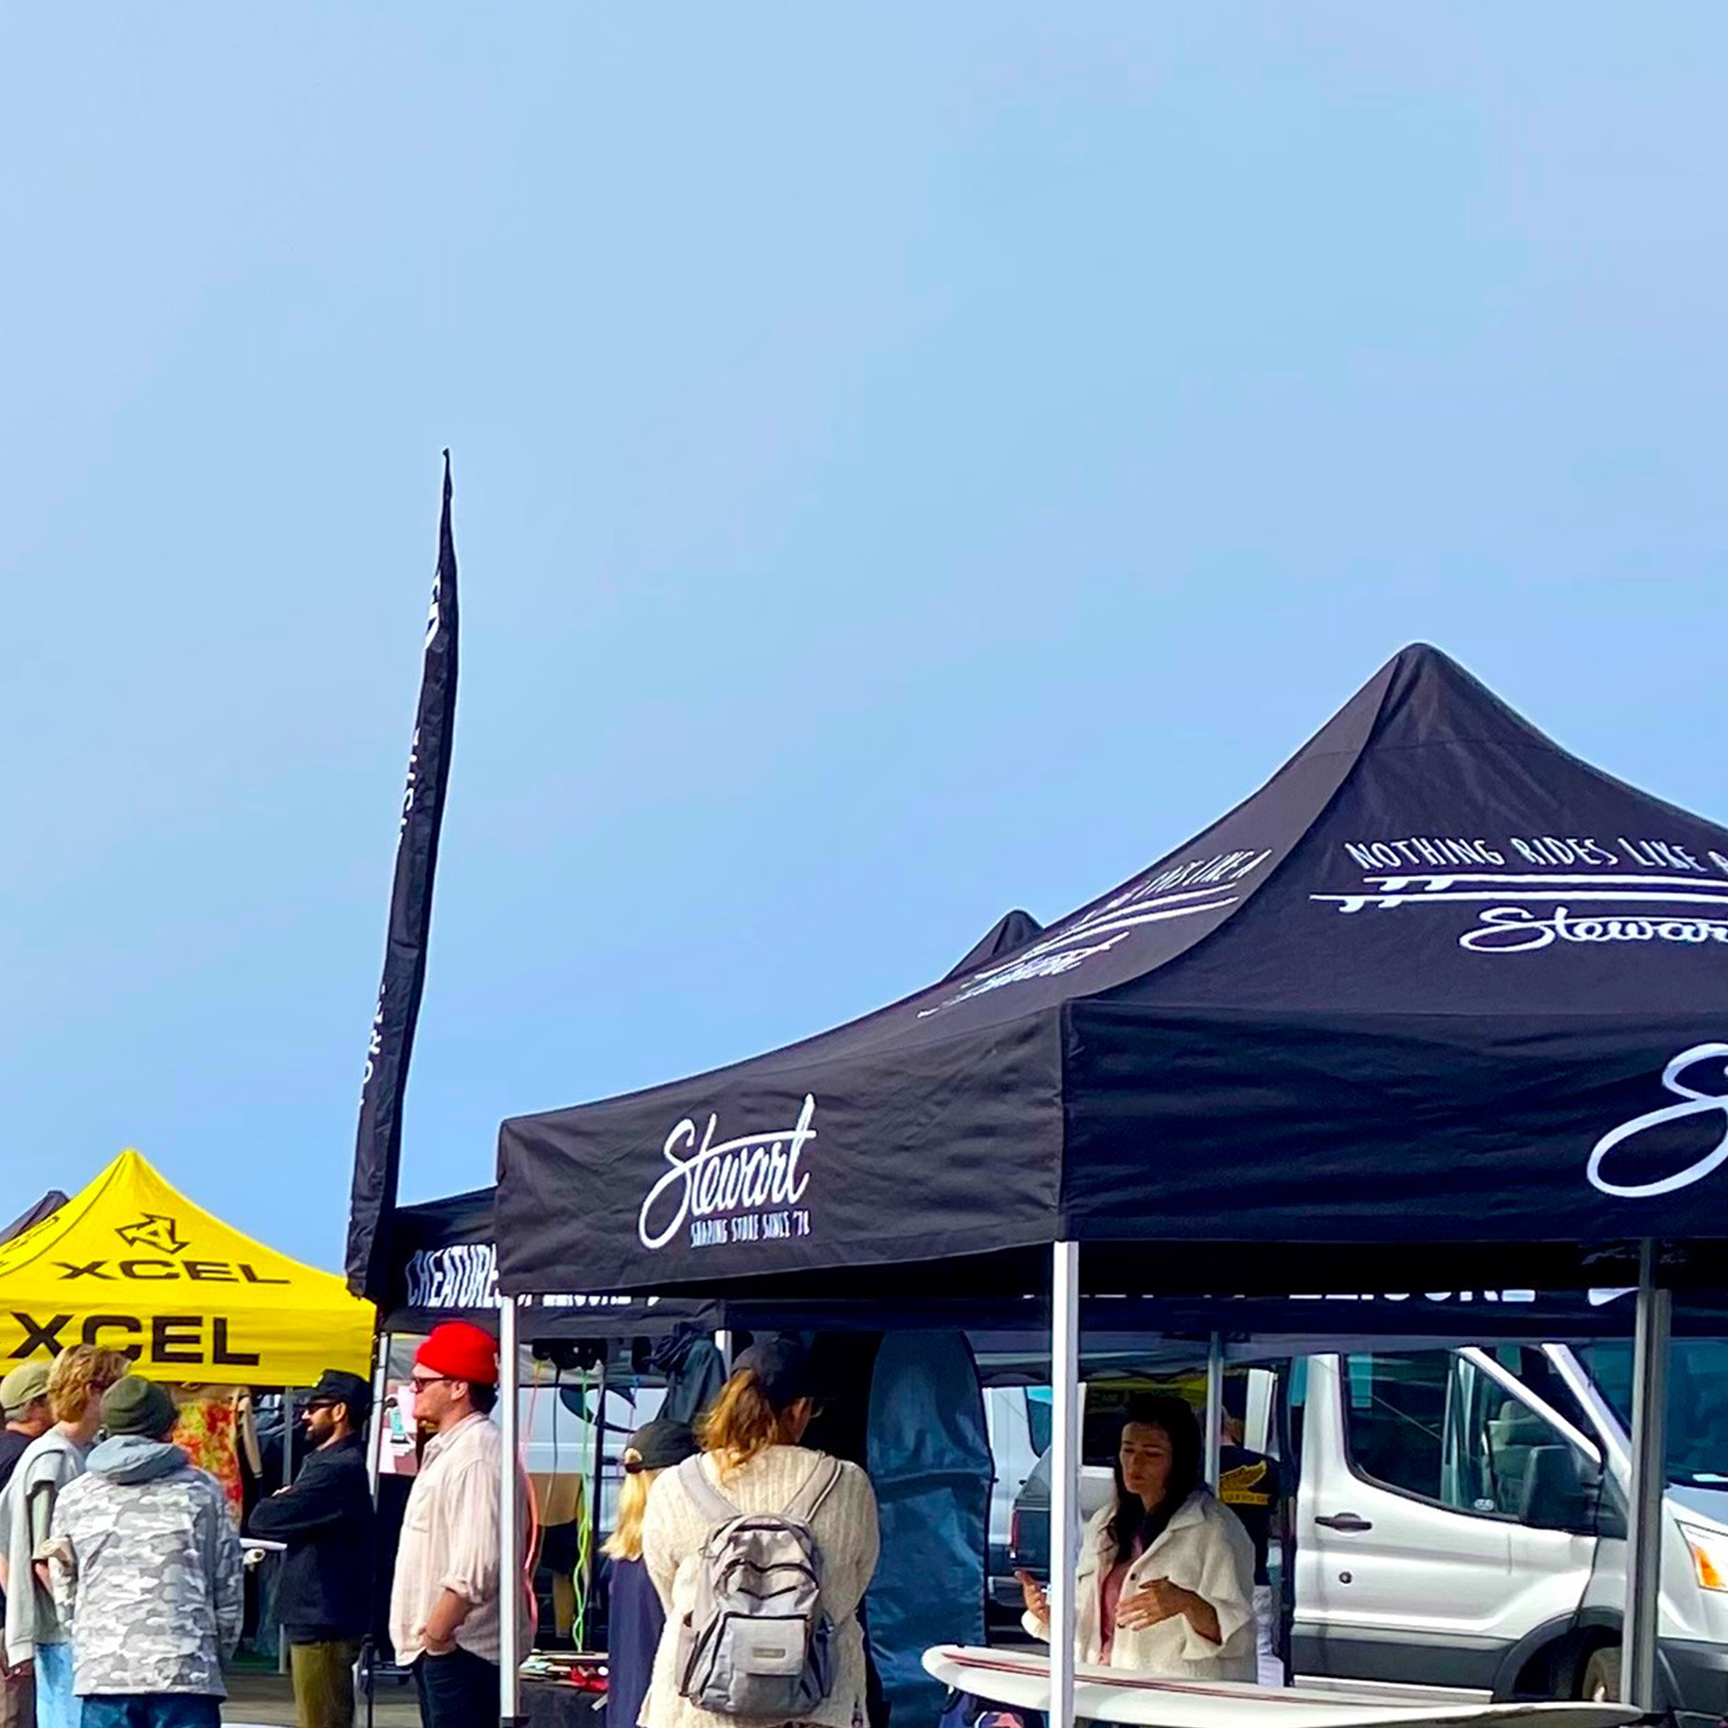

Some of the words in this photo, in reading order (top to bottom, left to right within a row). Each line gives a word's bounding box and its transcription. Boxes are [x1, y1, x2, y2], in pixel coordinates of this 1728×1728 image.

[1345, 838, 1505, 870] NOTHING
[1510, 836, 1618, 867] RIDES
[1618, 838, 1709, 873] LIKE
[1459, 906, 1728, 953] Stewar
[639, 1093, 817, 1249] Stewart
[55, 1260, 291, 1286] XCEL
[7, 1312, 261, 1366] XCEL
